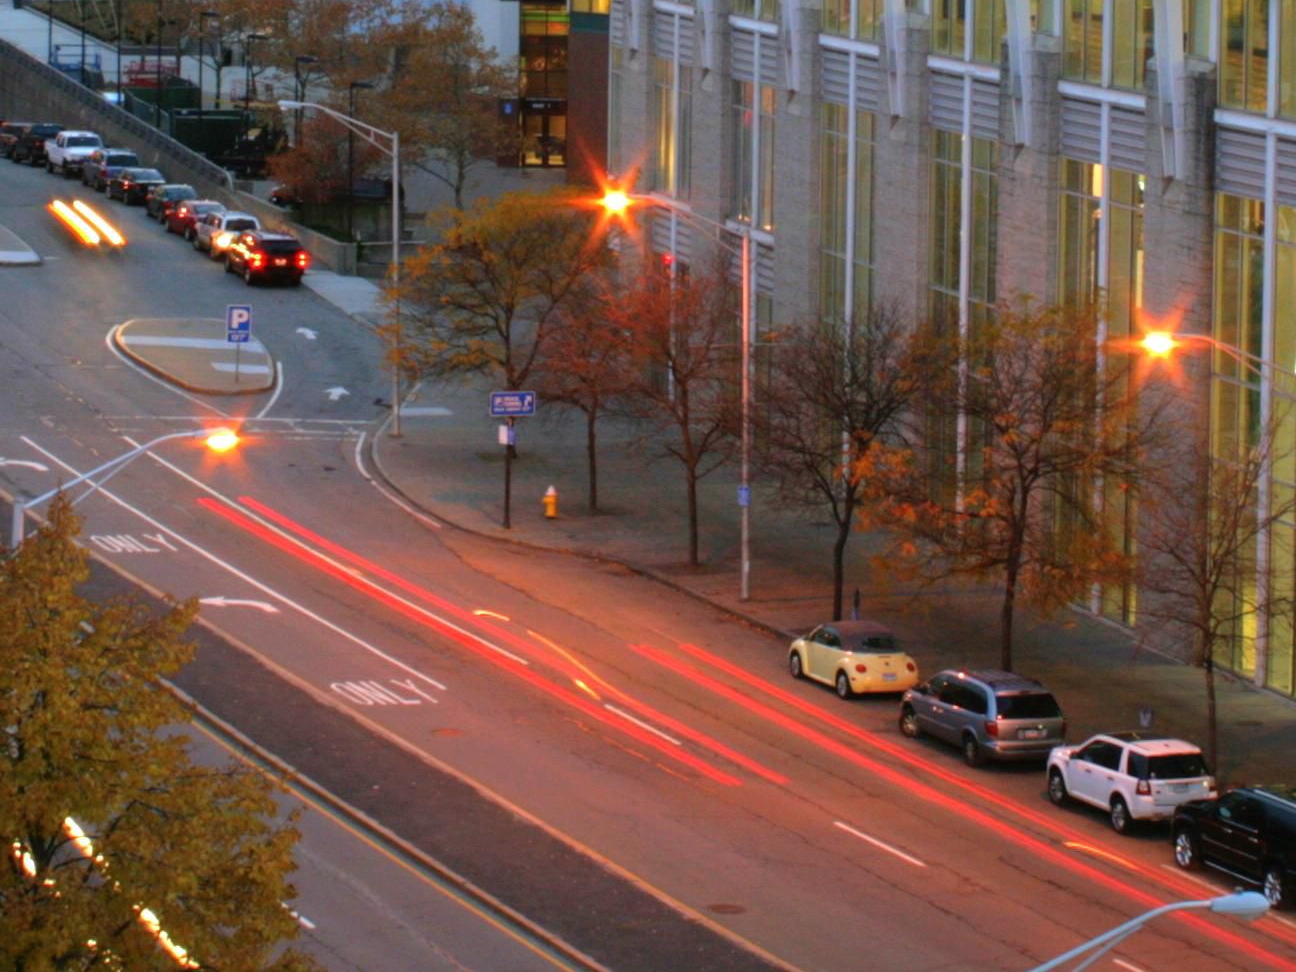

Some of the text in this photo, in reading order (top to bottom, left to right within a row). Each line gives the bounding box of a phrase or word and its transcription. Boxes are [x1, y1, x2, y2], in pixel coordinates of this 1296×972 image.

[231, 308, 250, 329] P
[90, 534, 178, 553] ONLY
[330, 680, 439, 705] ONLY
